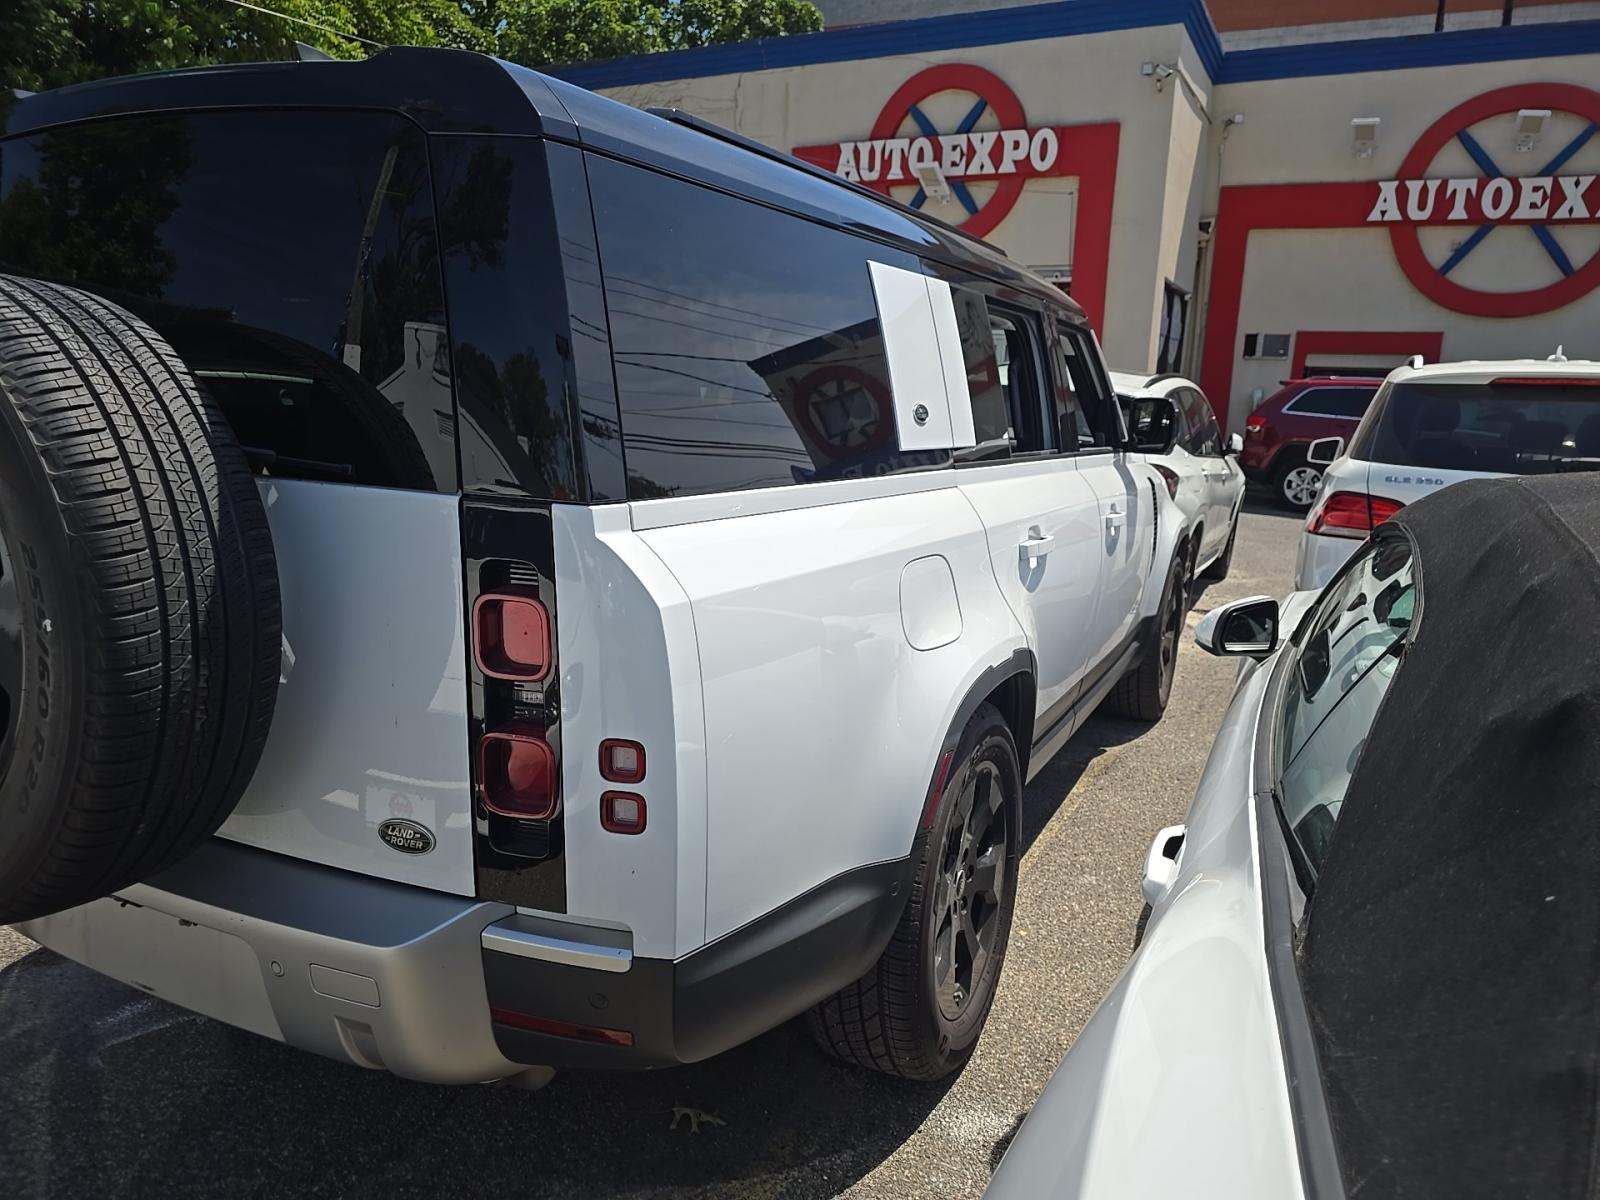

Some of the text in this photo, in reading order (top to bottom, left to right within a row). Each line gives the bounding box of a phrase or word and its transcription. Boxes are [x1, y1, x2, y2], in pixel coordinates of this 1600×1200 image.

[835, 128, 1058, 182] AUTOEXPO
[1366, 175, 1600, 222] AUTOEX
[388, 826, 414, 839] LAND
[391, 838, 423, 849] ROVER
